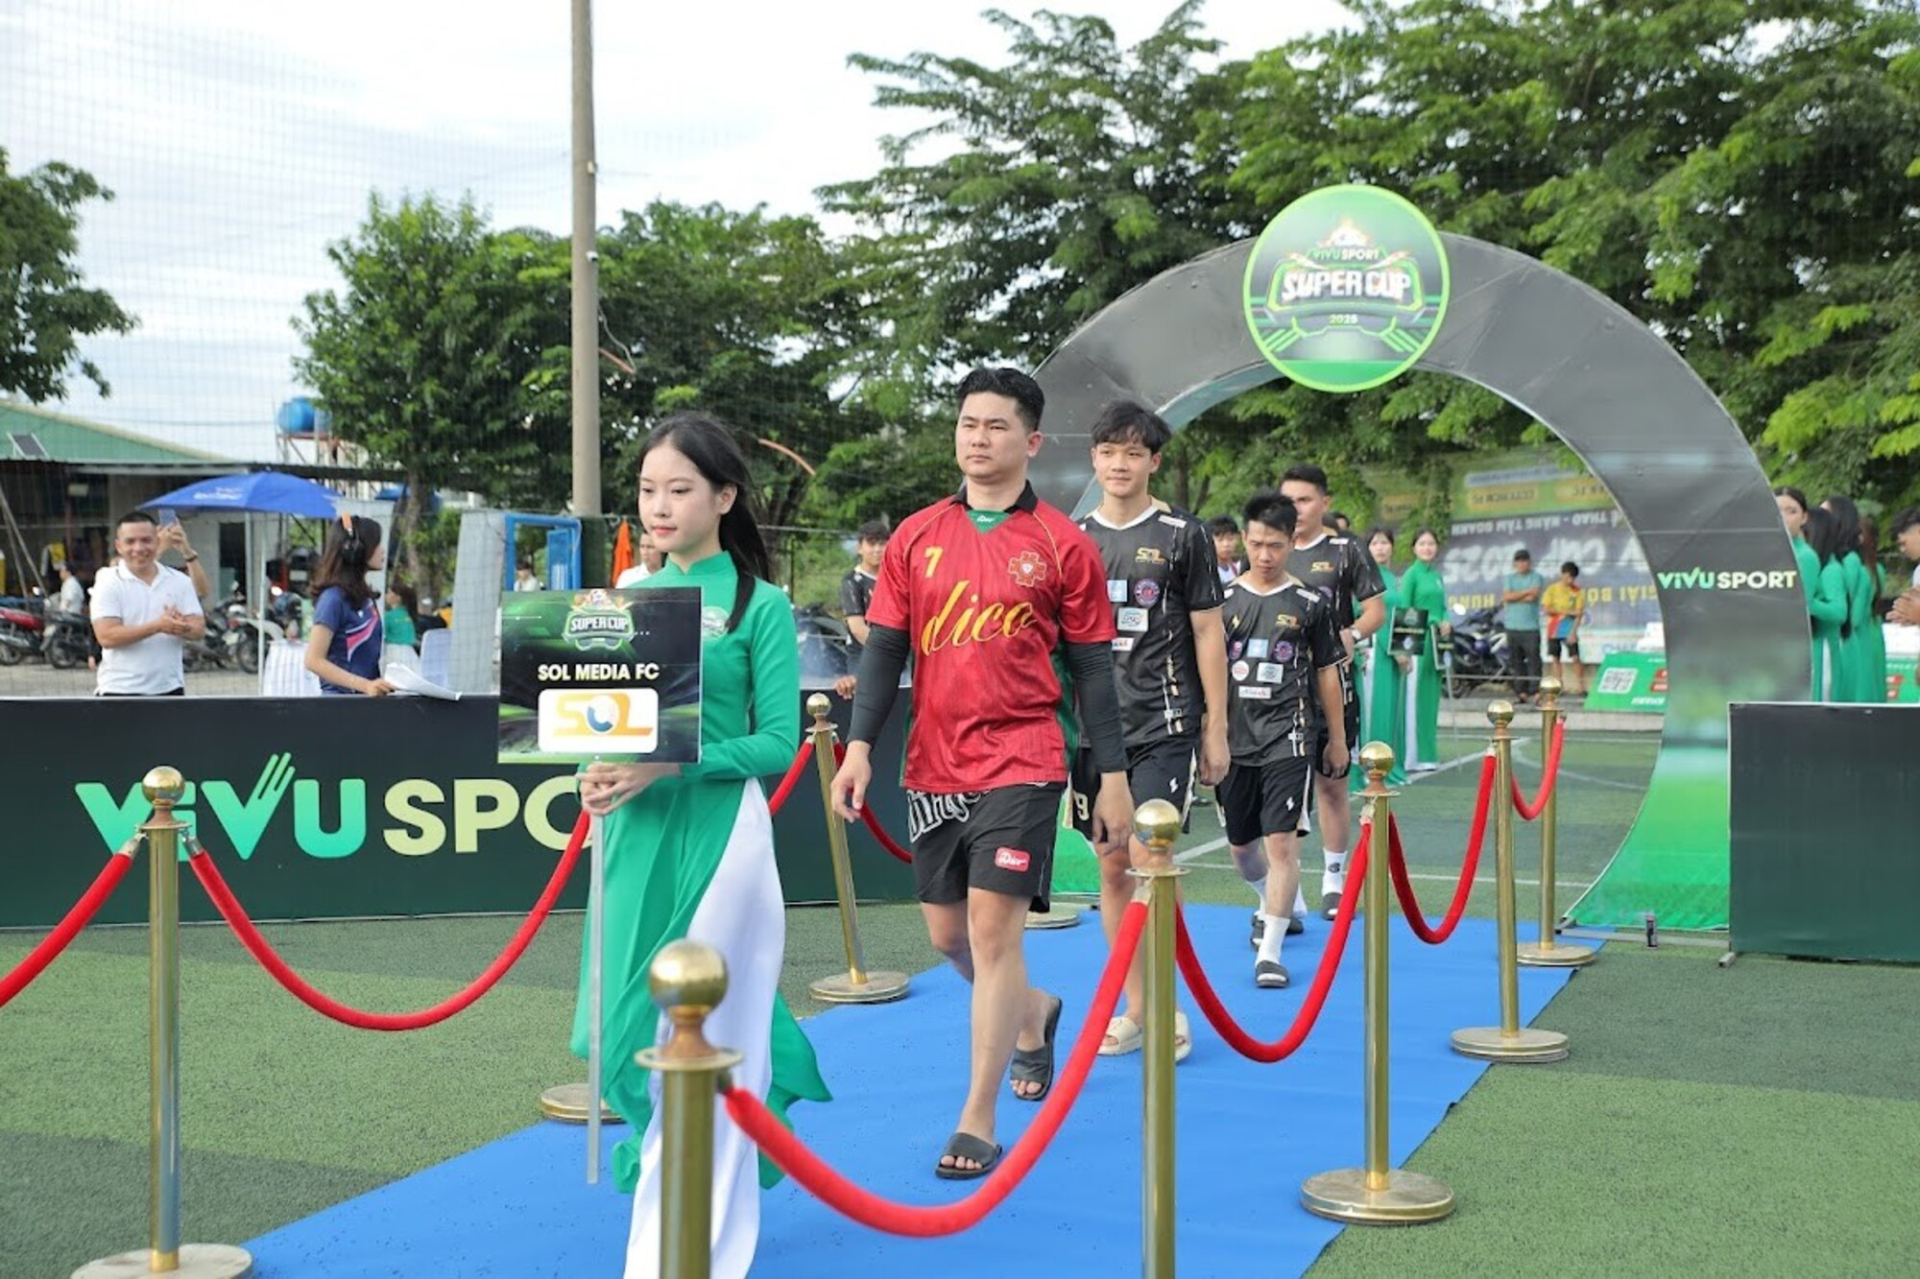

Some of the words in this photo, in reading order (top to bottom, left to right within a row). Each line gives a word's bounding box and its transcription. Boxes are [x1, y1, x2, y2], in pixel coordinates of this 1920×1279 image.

[1341, 249, 1379, 260] SPORT
[1282, 270, 1363, 302] SUPER
[1365, 270, 1411, 300] CUP
[1717, 570, 1797, 589] SPORT
[571, 617, 606, 632] SUPER
[608, 617, 628, 631] CUP
[538, 664, 571, 681] SOL
[575, 664, 630, 680] MEDIA
[635, 663, 660, 680] FC
[383, 778, 592, 856] SPO
